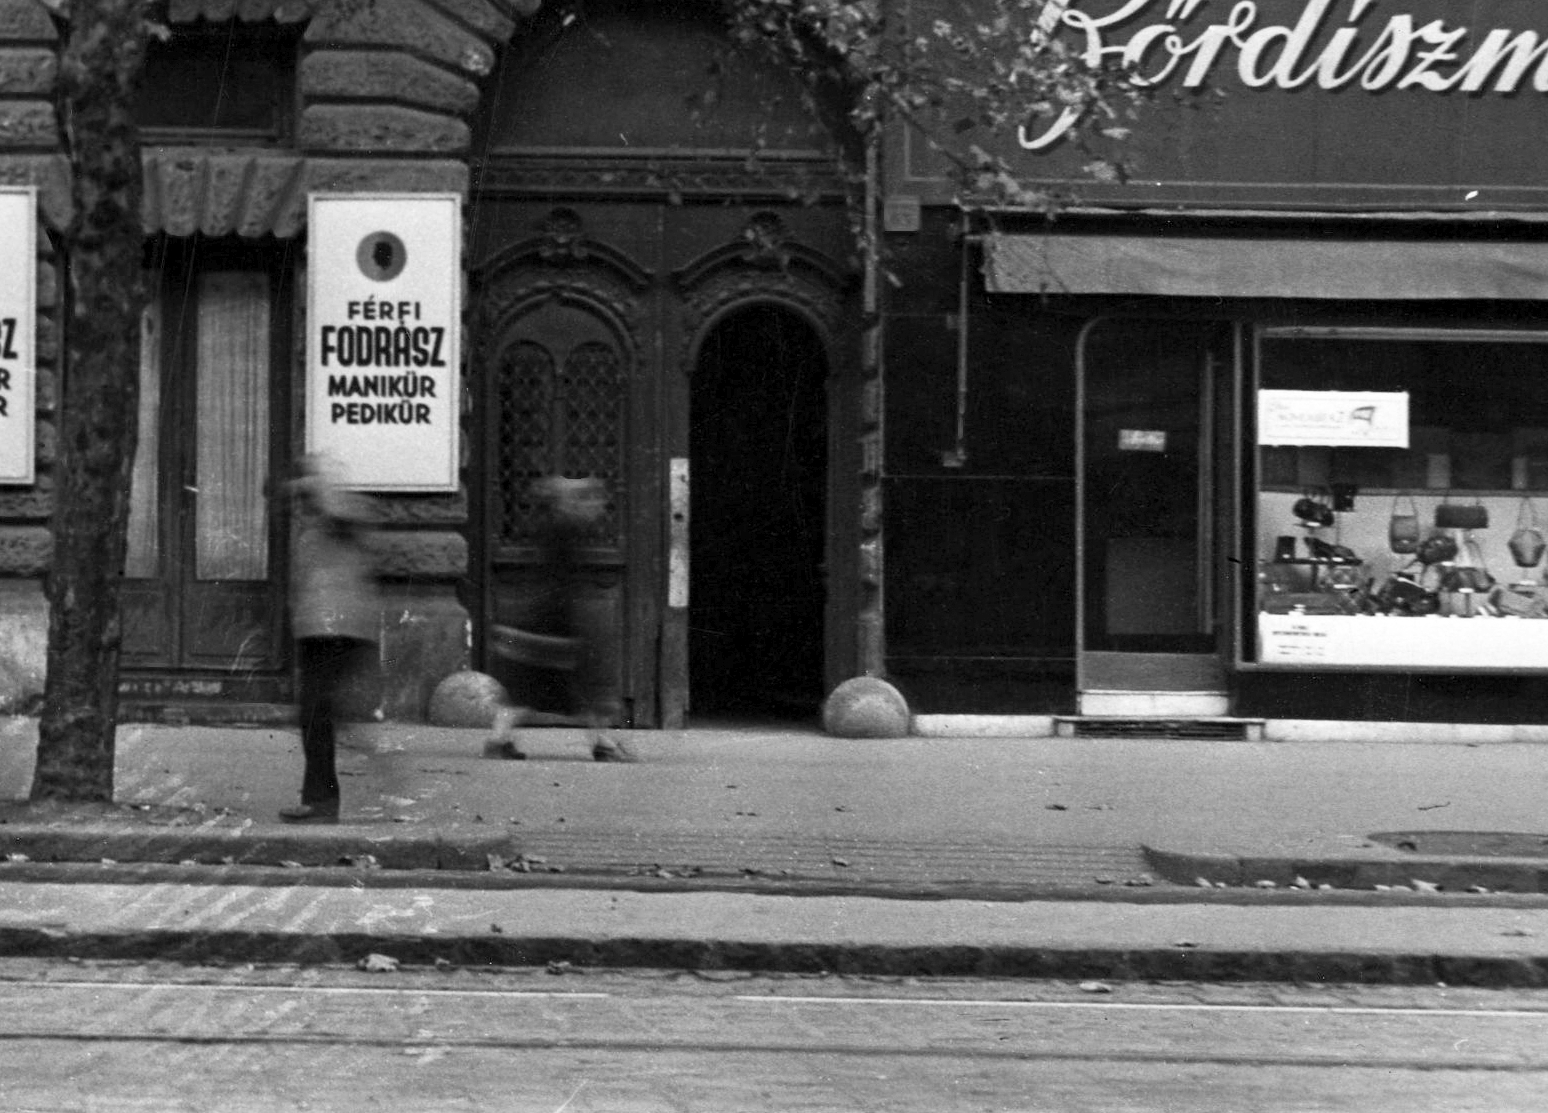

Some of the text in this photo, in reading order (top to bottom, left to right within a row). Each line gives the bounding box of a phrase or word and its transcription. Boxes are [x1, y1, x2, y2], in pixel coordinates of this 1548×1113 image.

[347, 294, 421, 321] FÉRFI
[321, 322, 446, 367] FODRÁSZ
[328, 371, 437, 399] MANIKÜR
[331, 400, 432, 425] PEDIKÜR
